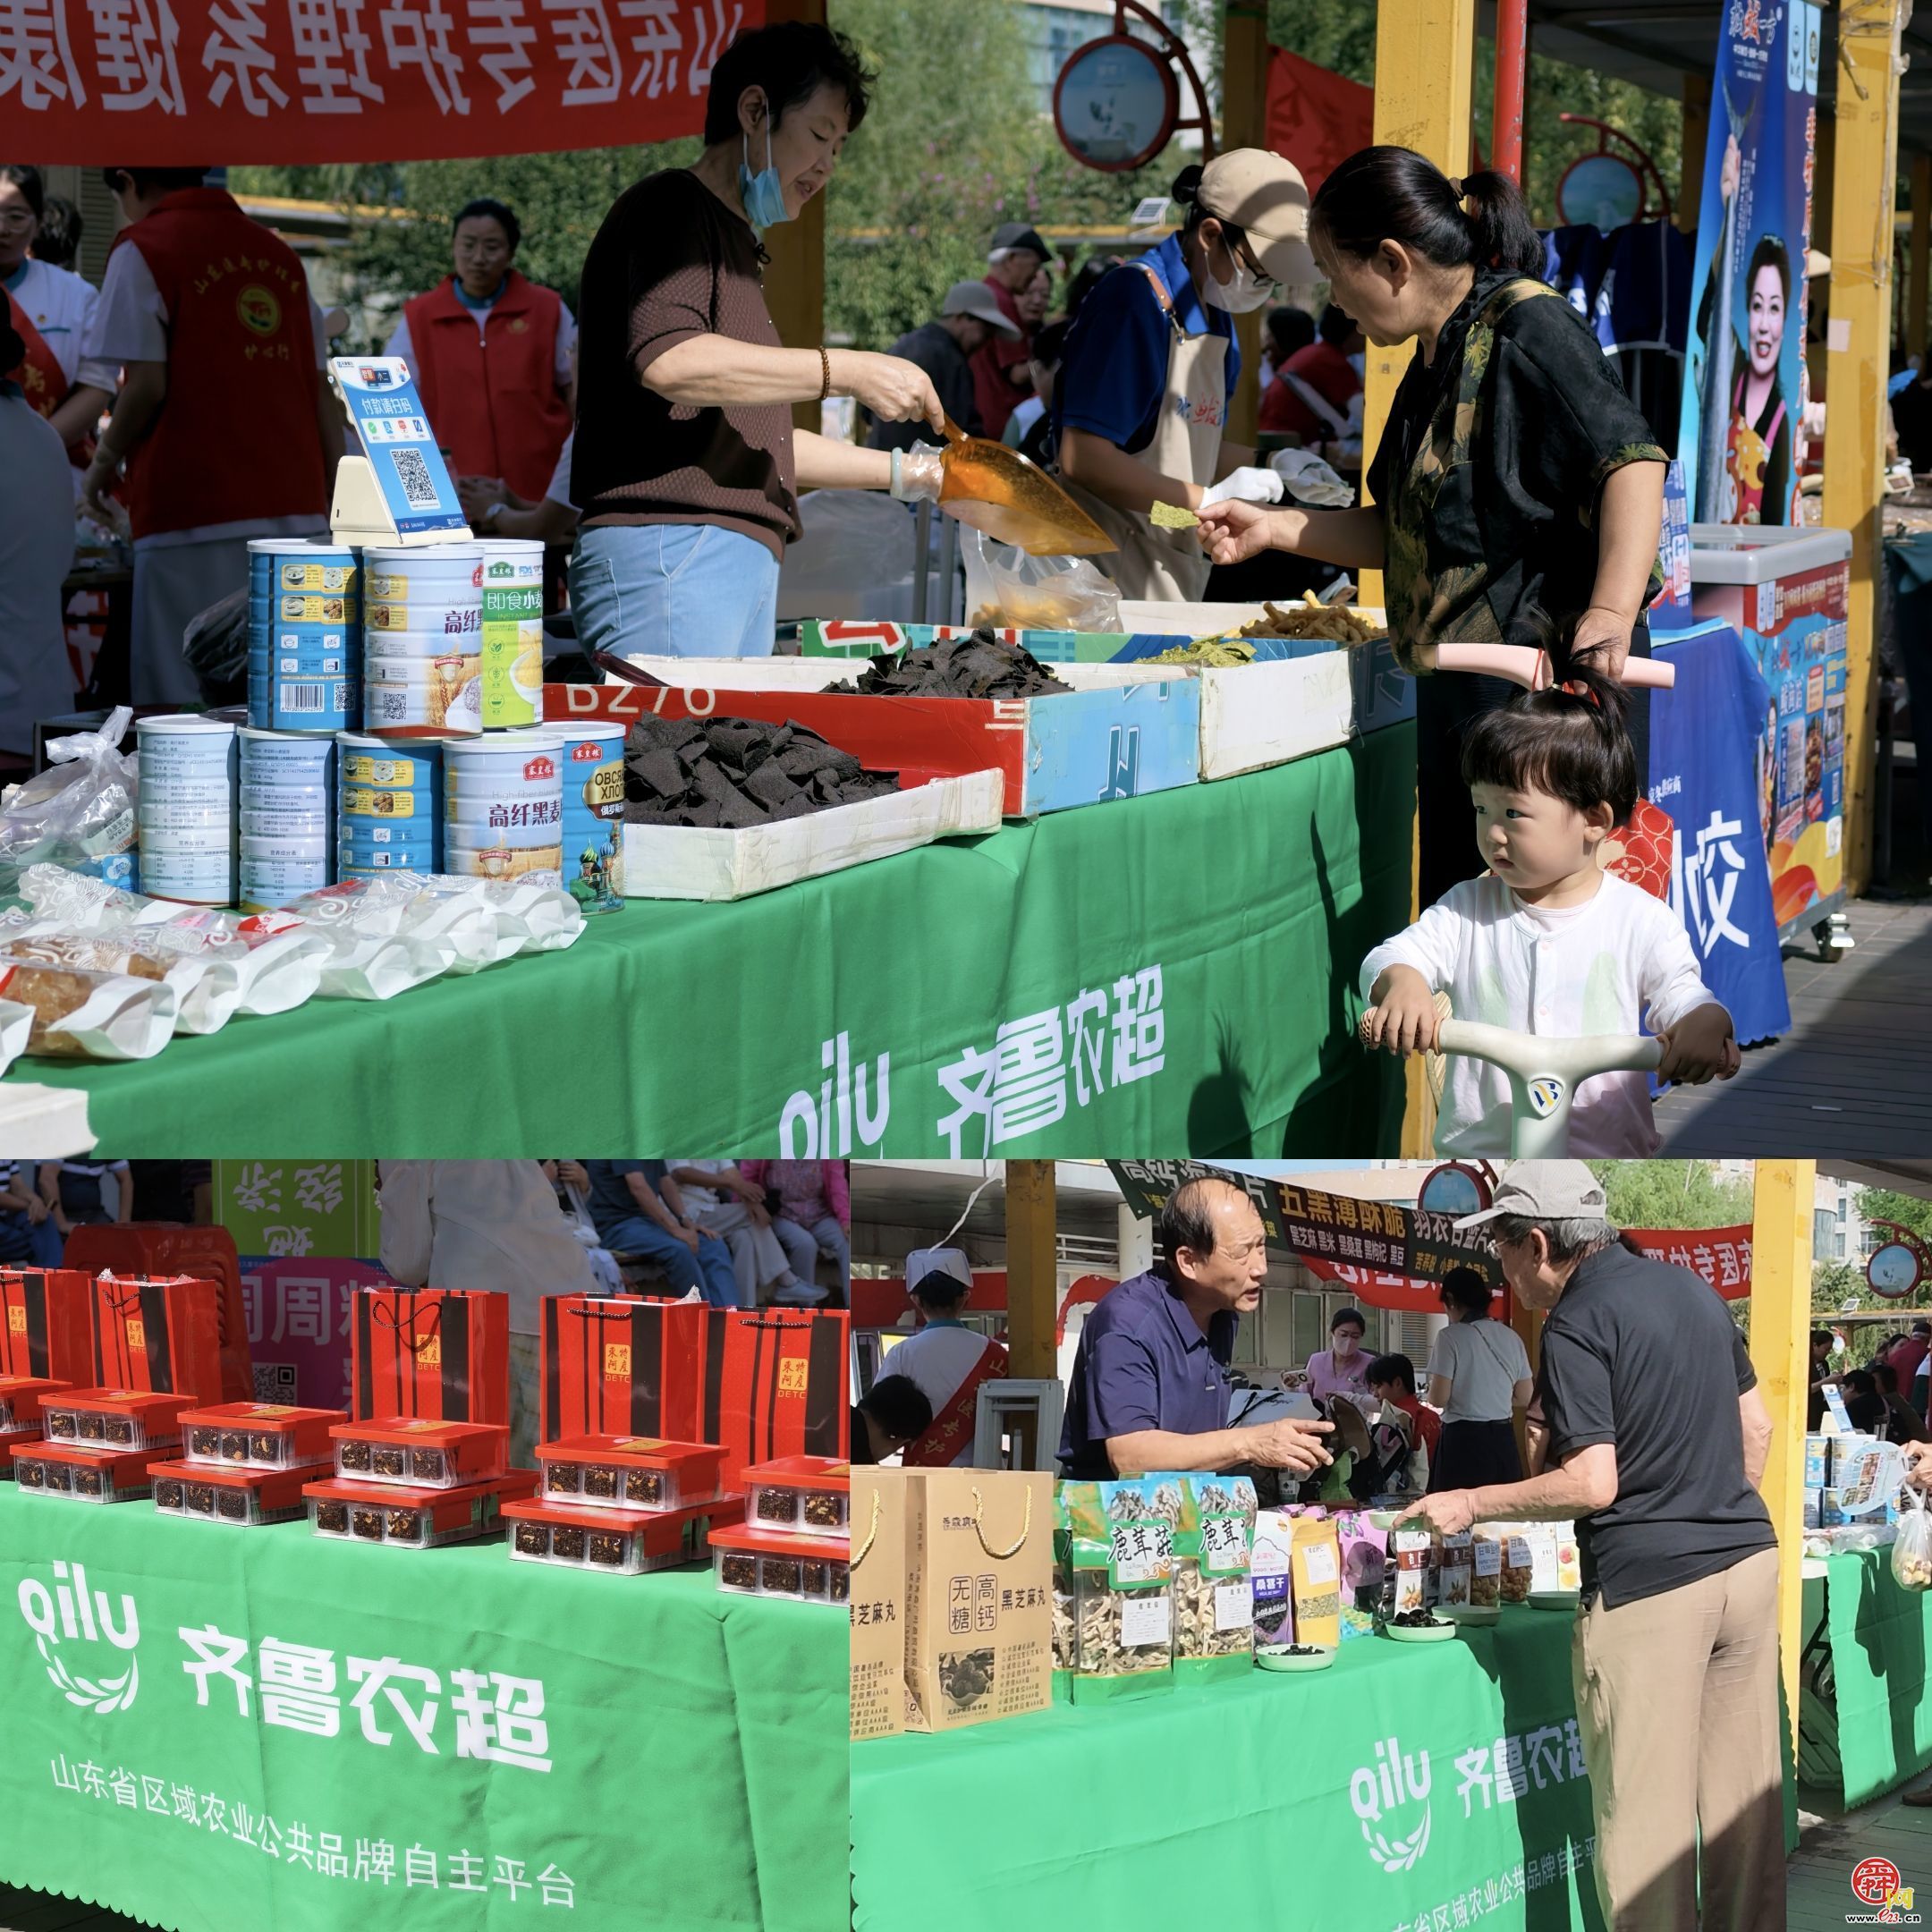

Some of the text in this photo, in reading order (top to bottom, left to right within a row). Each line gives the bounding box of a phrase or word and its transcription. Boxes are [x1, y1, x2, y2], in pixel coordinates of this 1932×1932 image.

[362, 398, 413, 415] 付款请扫码
[489, 801, 562, 828] 高纤黑麦
[936, 963, 1165, 1159] 齐鲁农超
[1279, 1184, 1406, 1239] 五黑薄酥脆
[1290, 1224, 1318, 1250] 黑芝麻
[606, 1375, 631, 1384] DETC
[777, 1390, 806, 1399] DETC
[1107, 1522, 1174, 1563] 鹿茸菇
[1408, 1552, 1426, 1565] 杏仁
[951, 1579, 970, 1631] 无糖
[977, 1578, 996, 1629] 高钙
[1001, 1585, 1046, 1612] 黑芝麻丸
[179, 1623, 553, 1773] 齐鲁农超
[1454, 1718, 1589, 1818] 齐鲁农超
[49, 1752, 576, 1909] 山东省区域农业公共品牌自主平台
